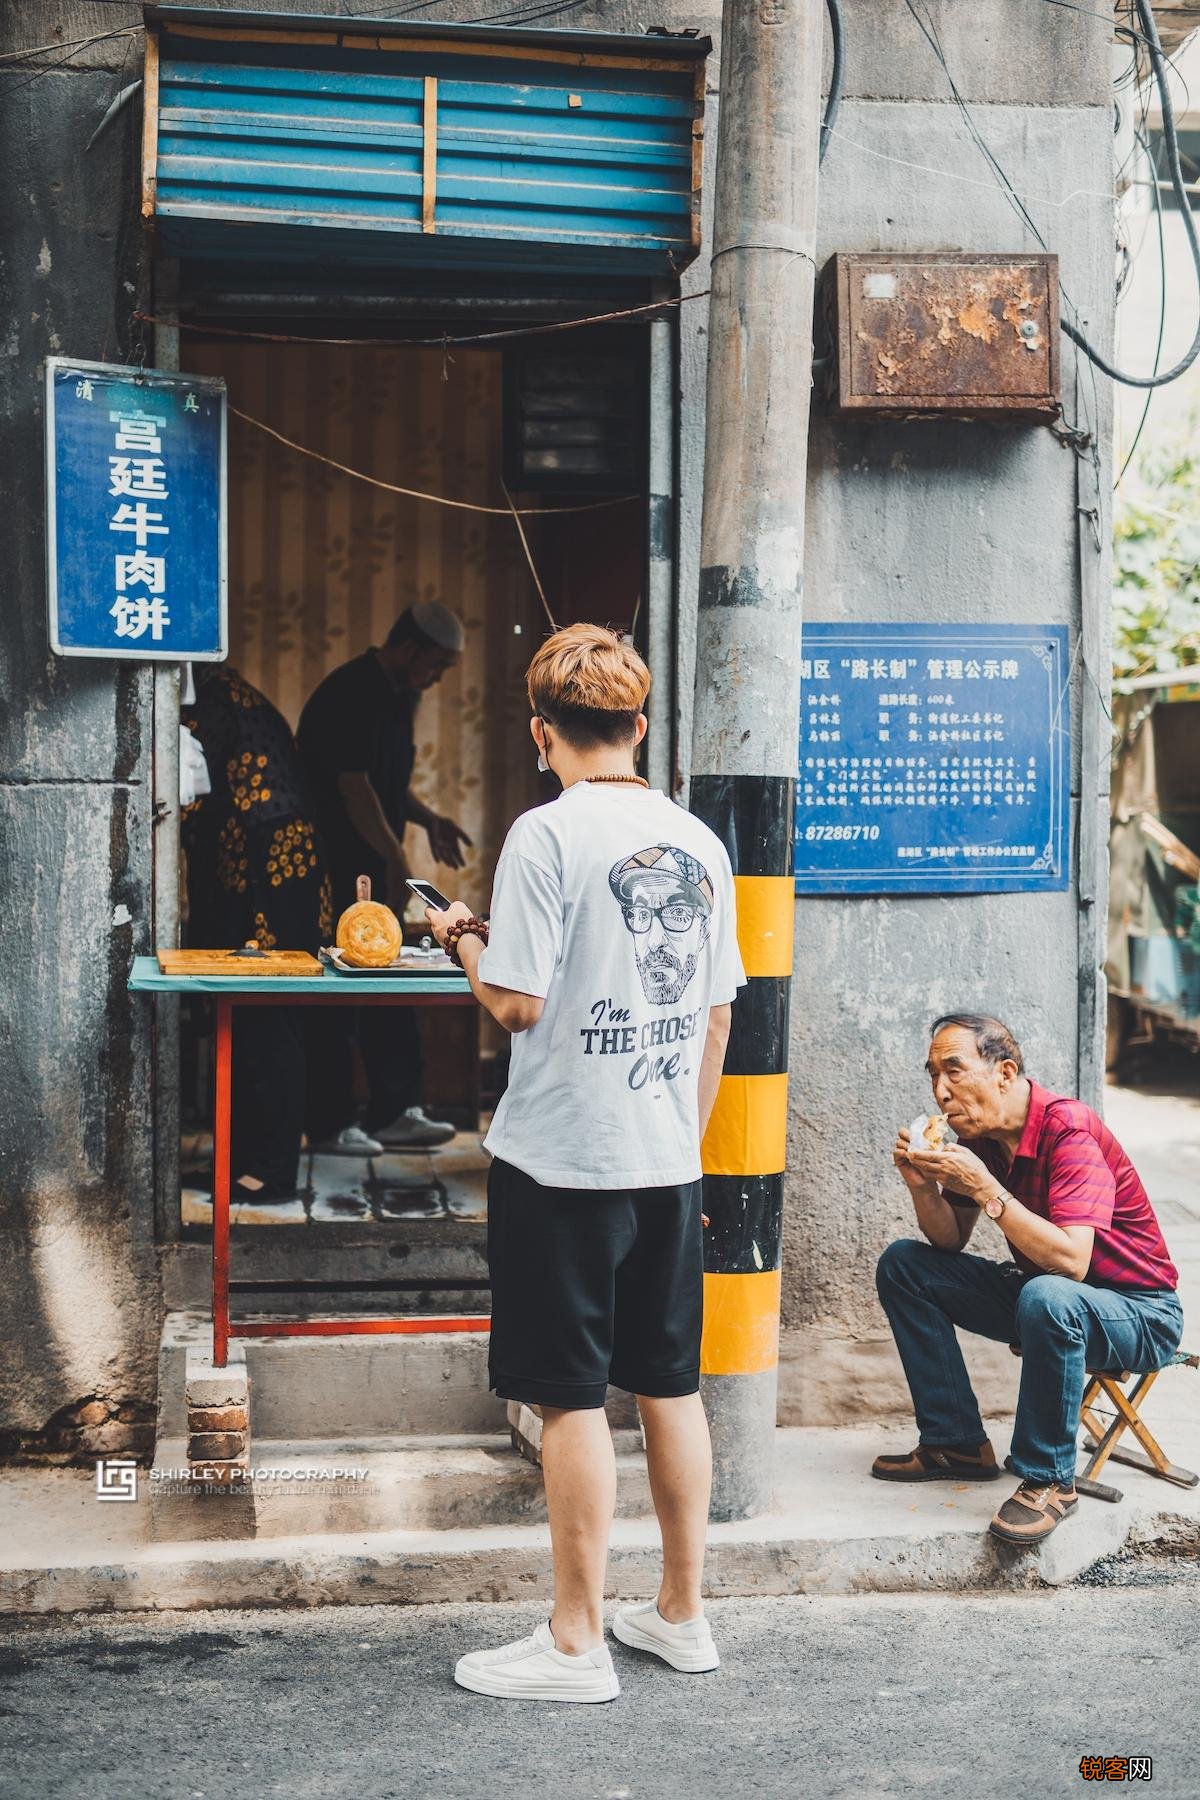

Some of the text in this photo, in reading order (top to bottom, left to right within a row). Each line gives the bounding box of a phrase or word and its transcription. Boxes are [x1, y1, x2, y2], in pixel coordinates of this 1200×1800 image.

[76, 379, 200, 413] 清 真
[108, 409, 171, 641] 宫廷牛肉饼
[580, 1009, 700, 1055] THE CHOSE
[591, 998, 630, 1026] I'm
